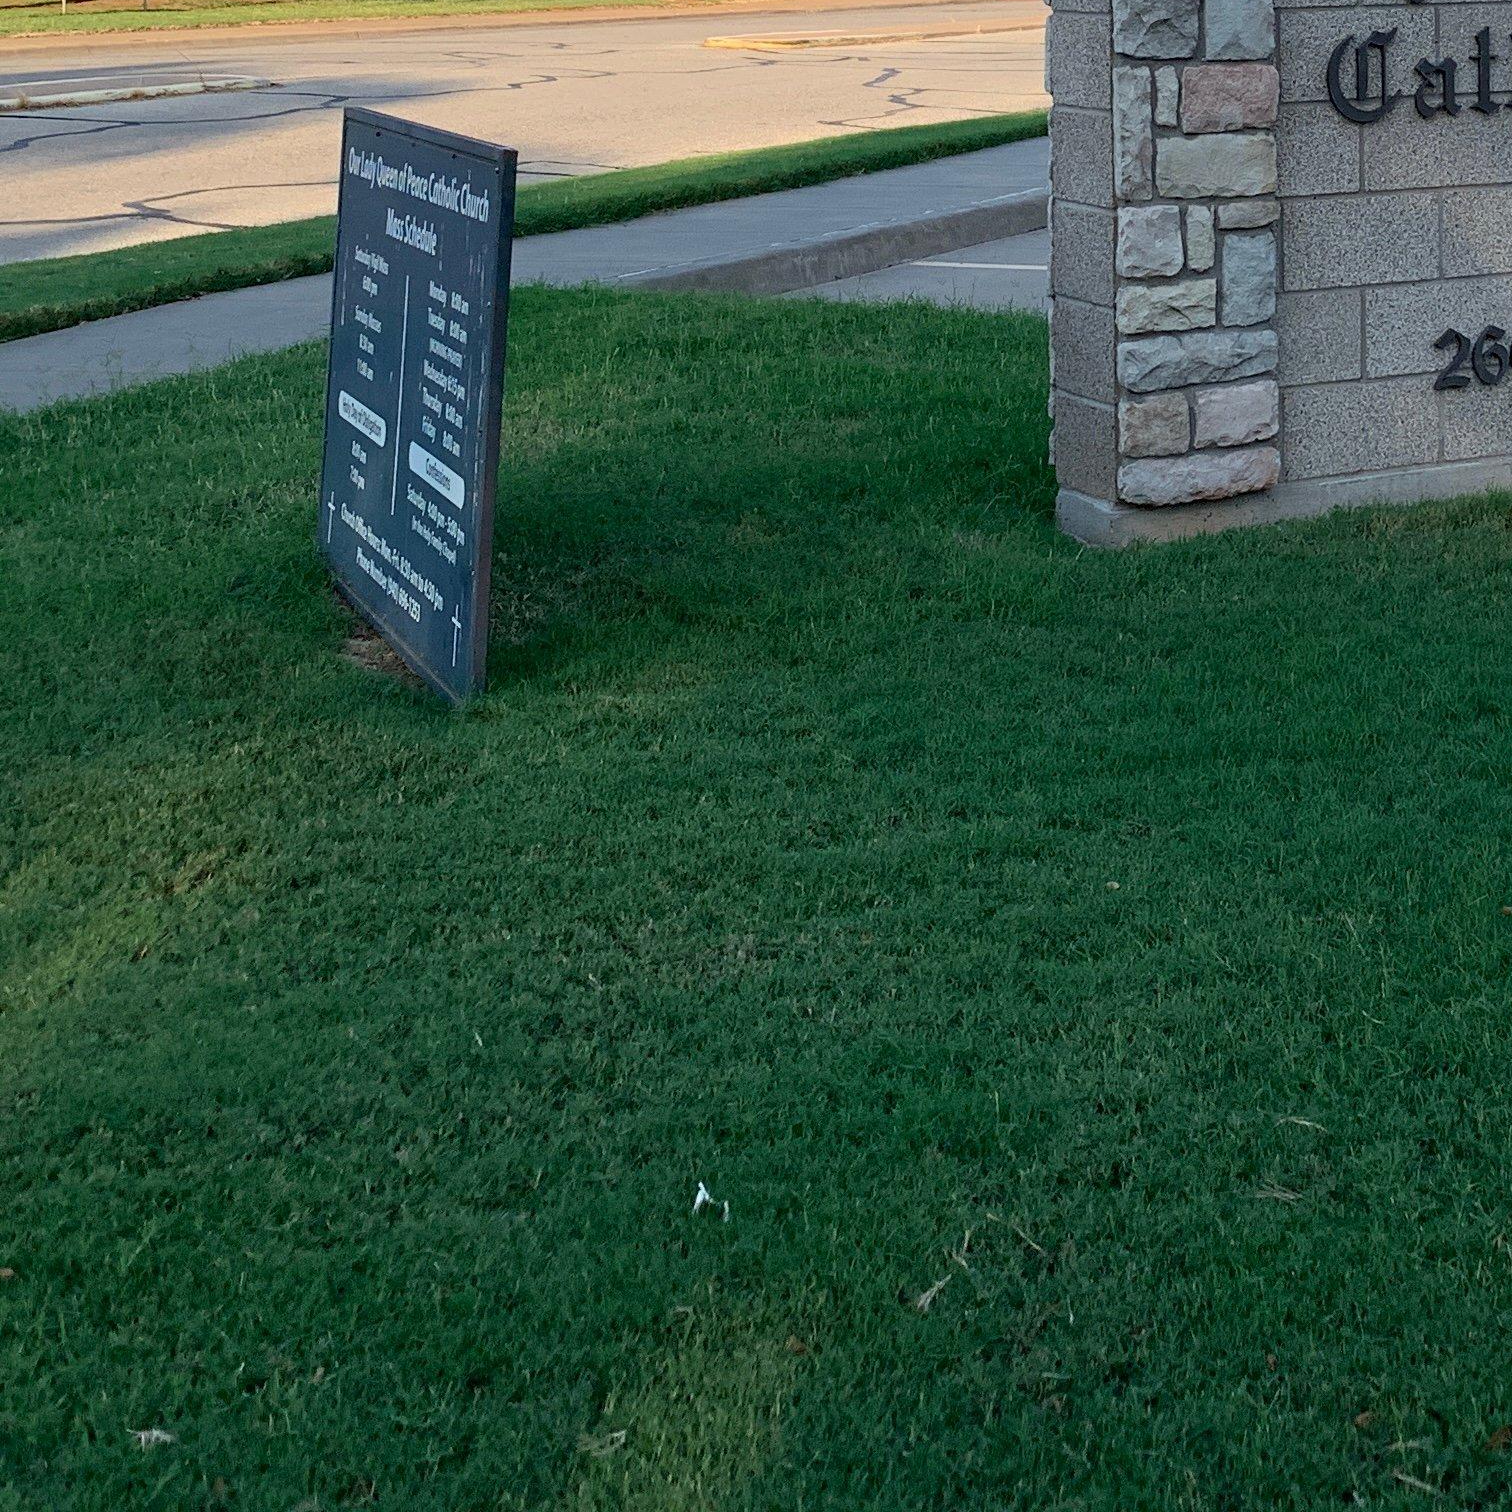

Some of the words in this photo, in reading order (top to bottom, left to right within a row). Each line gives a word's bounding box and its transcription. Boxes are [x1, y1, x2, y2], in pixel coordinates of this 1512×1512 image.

[349, 147, 361, 175] Our
[360, 151, 378, 189] Lady
[377, 156, 398, 189] Queen
[398, 163, 408, 193] of
[406, 166, 428, 200] Peace
[428, 173, 461, 212] Catholic
[460, 183, 489, 222] Church
[386, 208, 404, 241] Mass
[404, 215, 437, 255] Schedule
